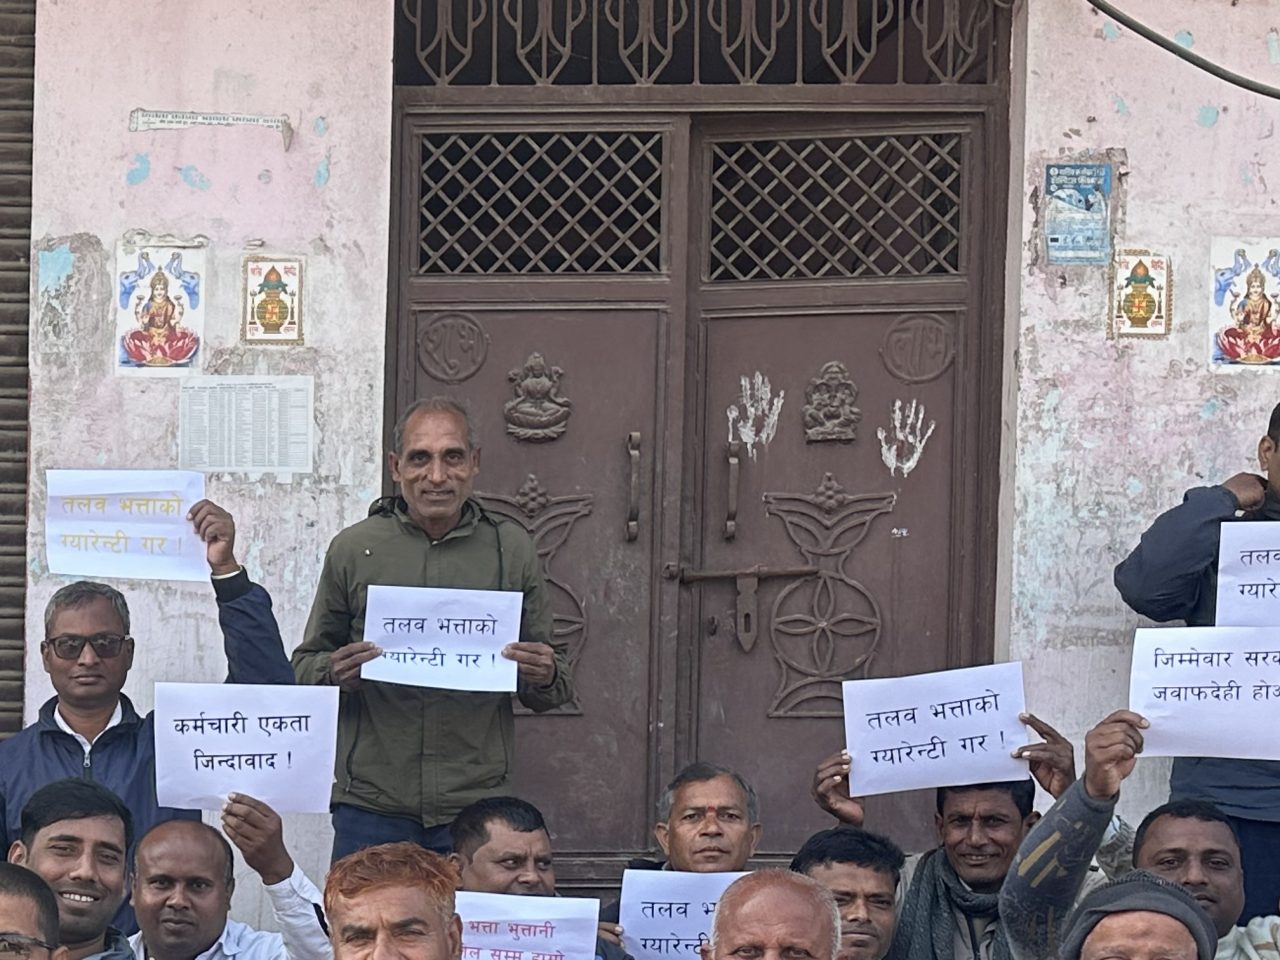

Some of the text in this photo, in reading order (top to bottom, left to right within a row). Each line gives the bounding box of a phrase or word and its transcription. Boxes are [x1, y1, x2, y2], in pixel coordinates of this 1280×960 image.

[60, 490, 183, 516] तलव भत्ताको
[59, 529, 130, 554] ग्यारेन्टी
[141, 536, 168, 556] गर
[382, 613, 499, 636] तलव भत्ताको
[455, 653, 482, 667] गर
[1154, 647, 1234, 668] जिम्मेवार
[1152, 679, 1243, 702] जवाफदेही
[865, 688, 1001, 729] तलव भत्ताको
[173, 710, 312, 737] कर्मचारी एकता
[193, 748, 278, 771] जिन्दावाद
[870, 735, 947, 765] ग्यारेन्टी
[958, 734, 988, 754] गर
[640, 901, 691, 919] तलव
[468, 920, 557, 942] भत्ता भुत्तानी
